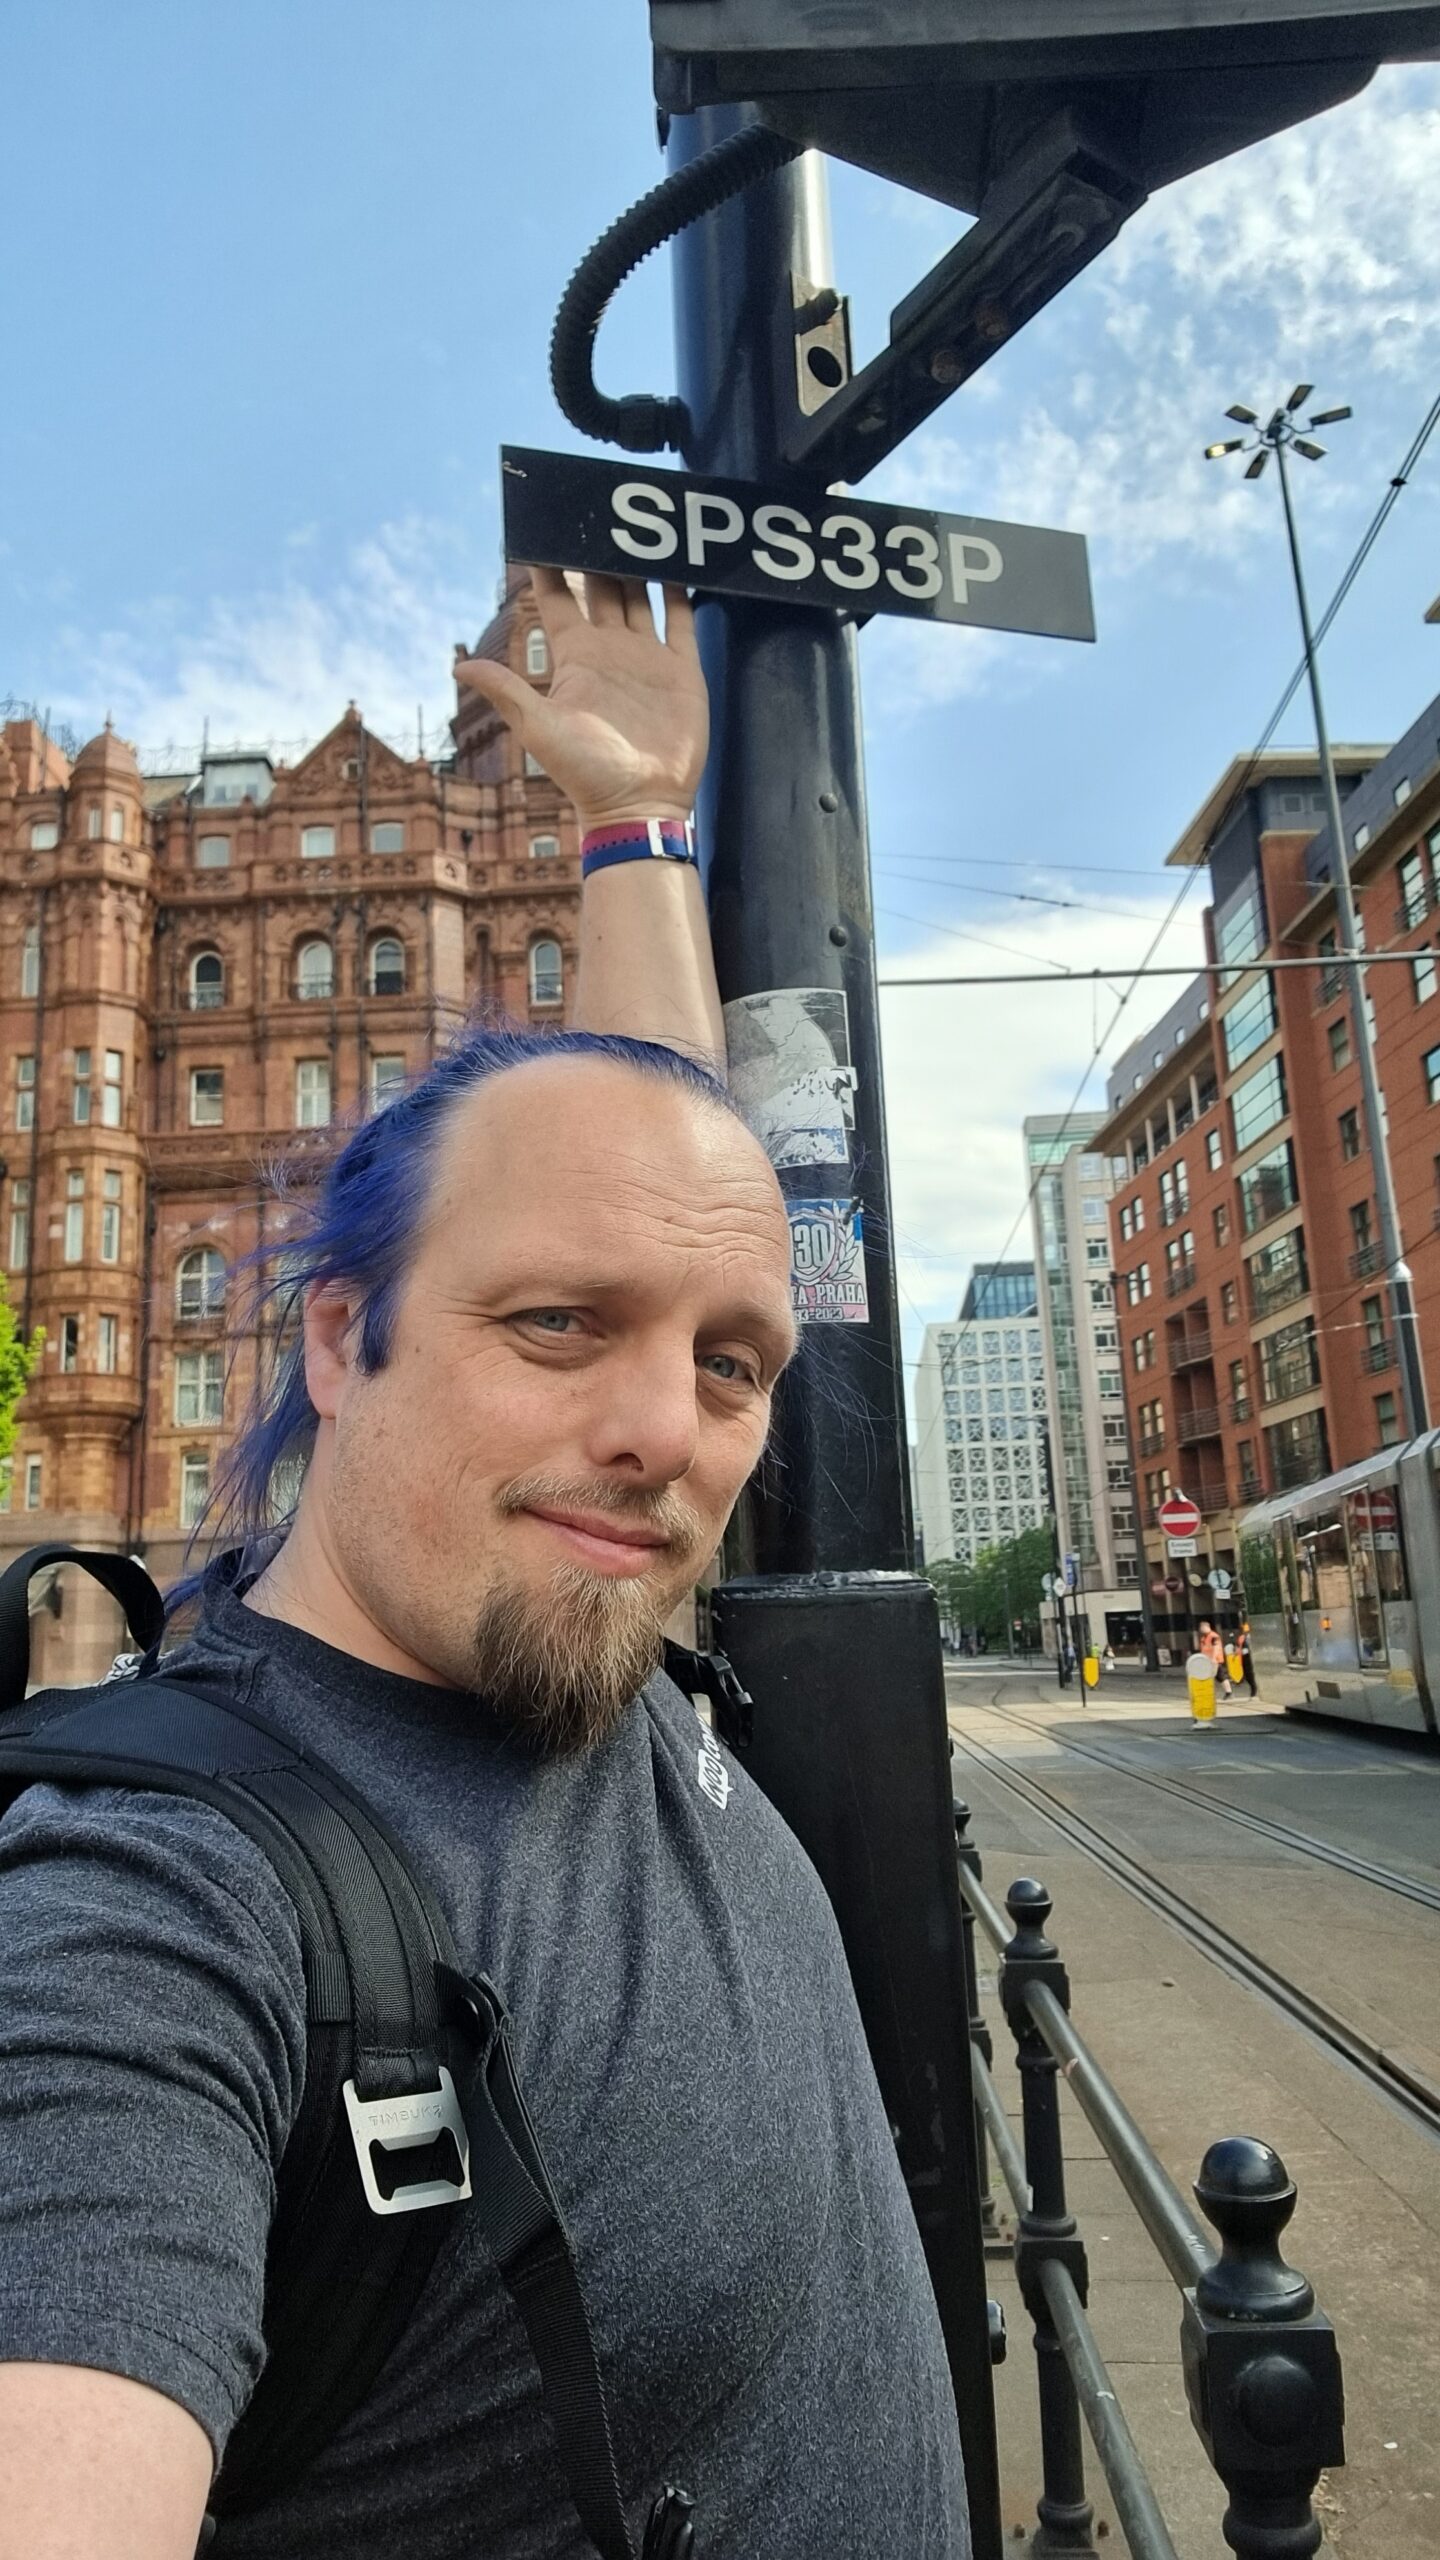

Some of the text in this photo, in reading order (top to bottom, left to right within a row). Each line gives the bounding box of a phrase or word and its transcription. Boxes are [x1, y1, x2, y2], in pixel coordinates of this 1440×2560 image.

[610, 482, 1003, 605] SPS33P
[793, 1223, 830, 1268] 30
[815, 1283, 865, 1304] PRAHA
